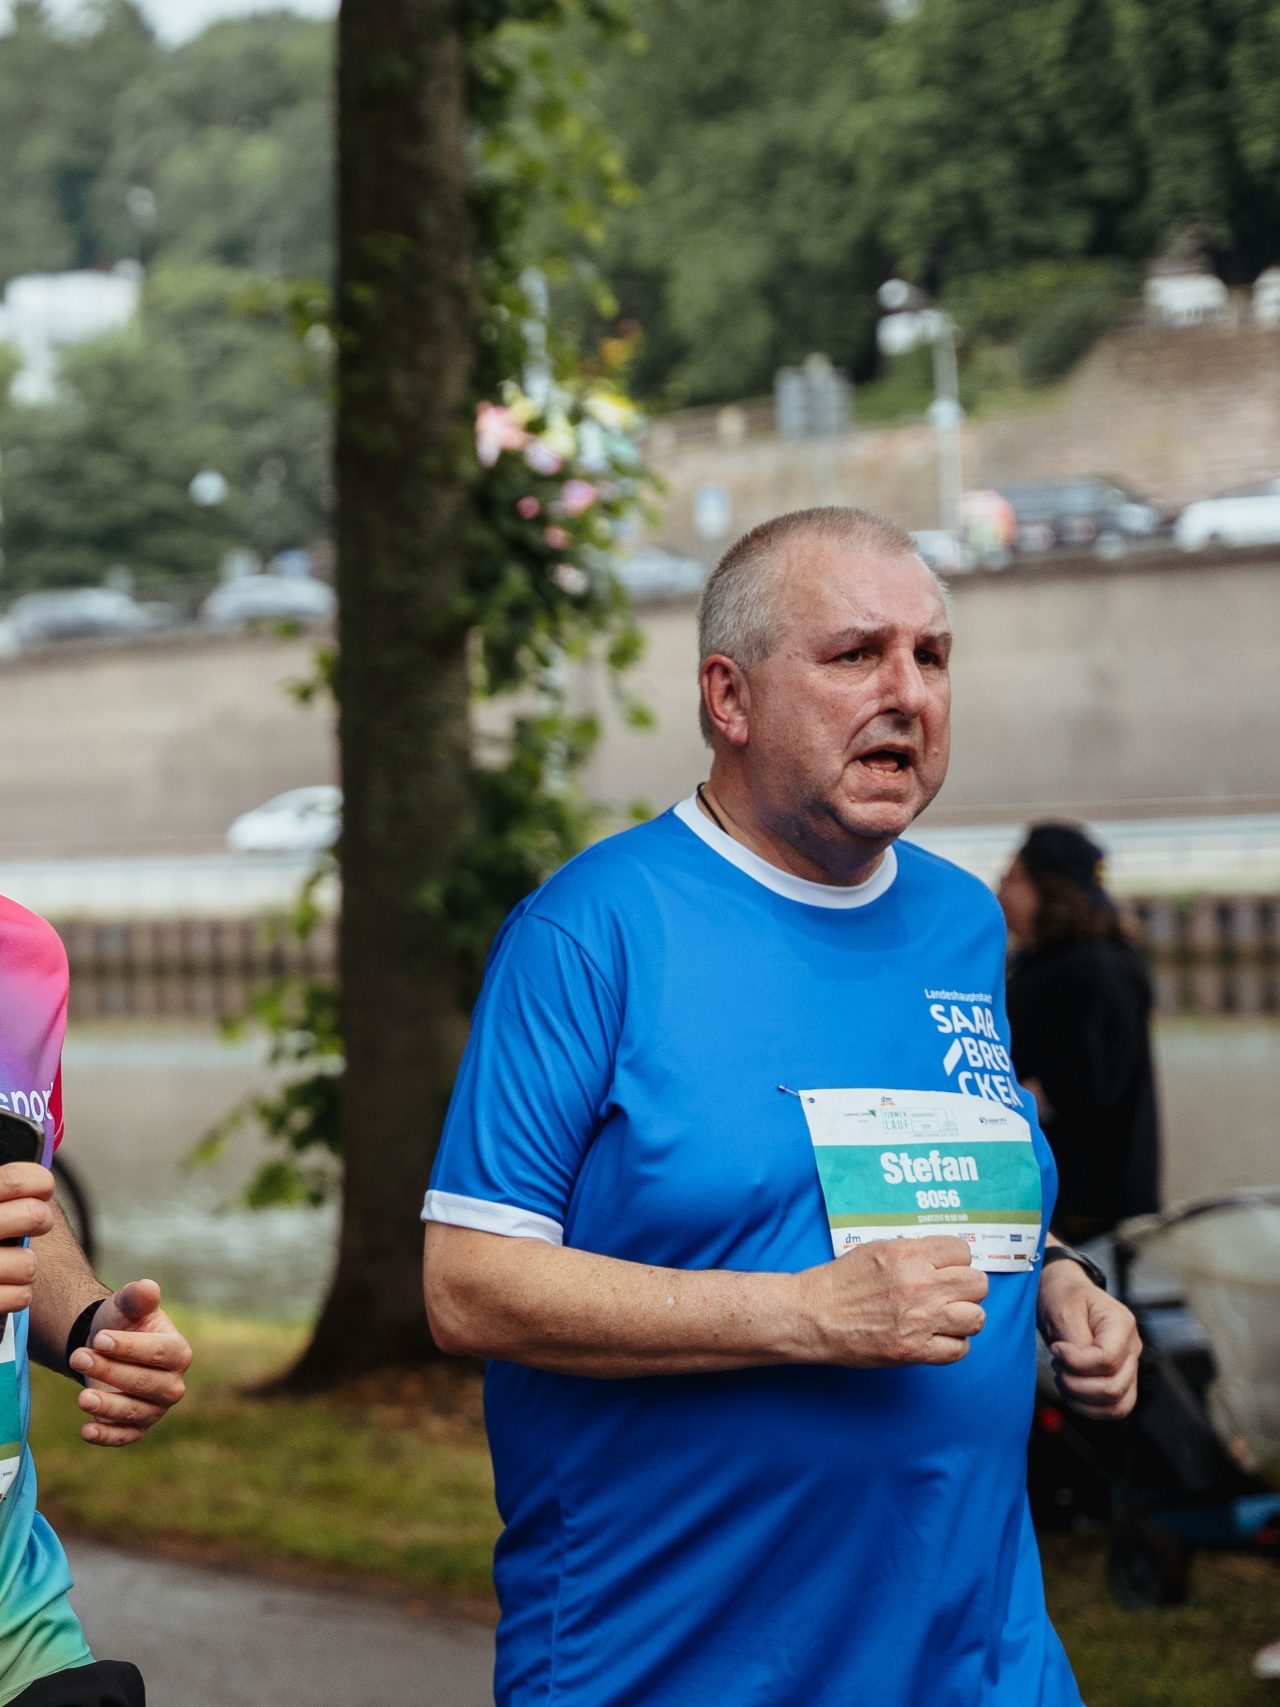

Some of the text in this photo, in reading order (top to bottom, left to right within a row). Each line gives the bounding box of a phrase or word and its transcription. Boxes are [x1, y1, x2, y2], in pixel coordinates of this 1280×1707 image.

[929, 1003, 1001, 1042] SAAR
[879, 1149, 979, 1185] Stefan
[915, 1189, 961, 1209] 8056
[845, 1233, 861, 1244] dm
